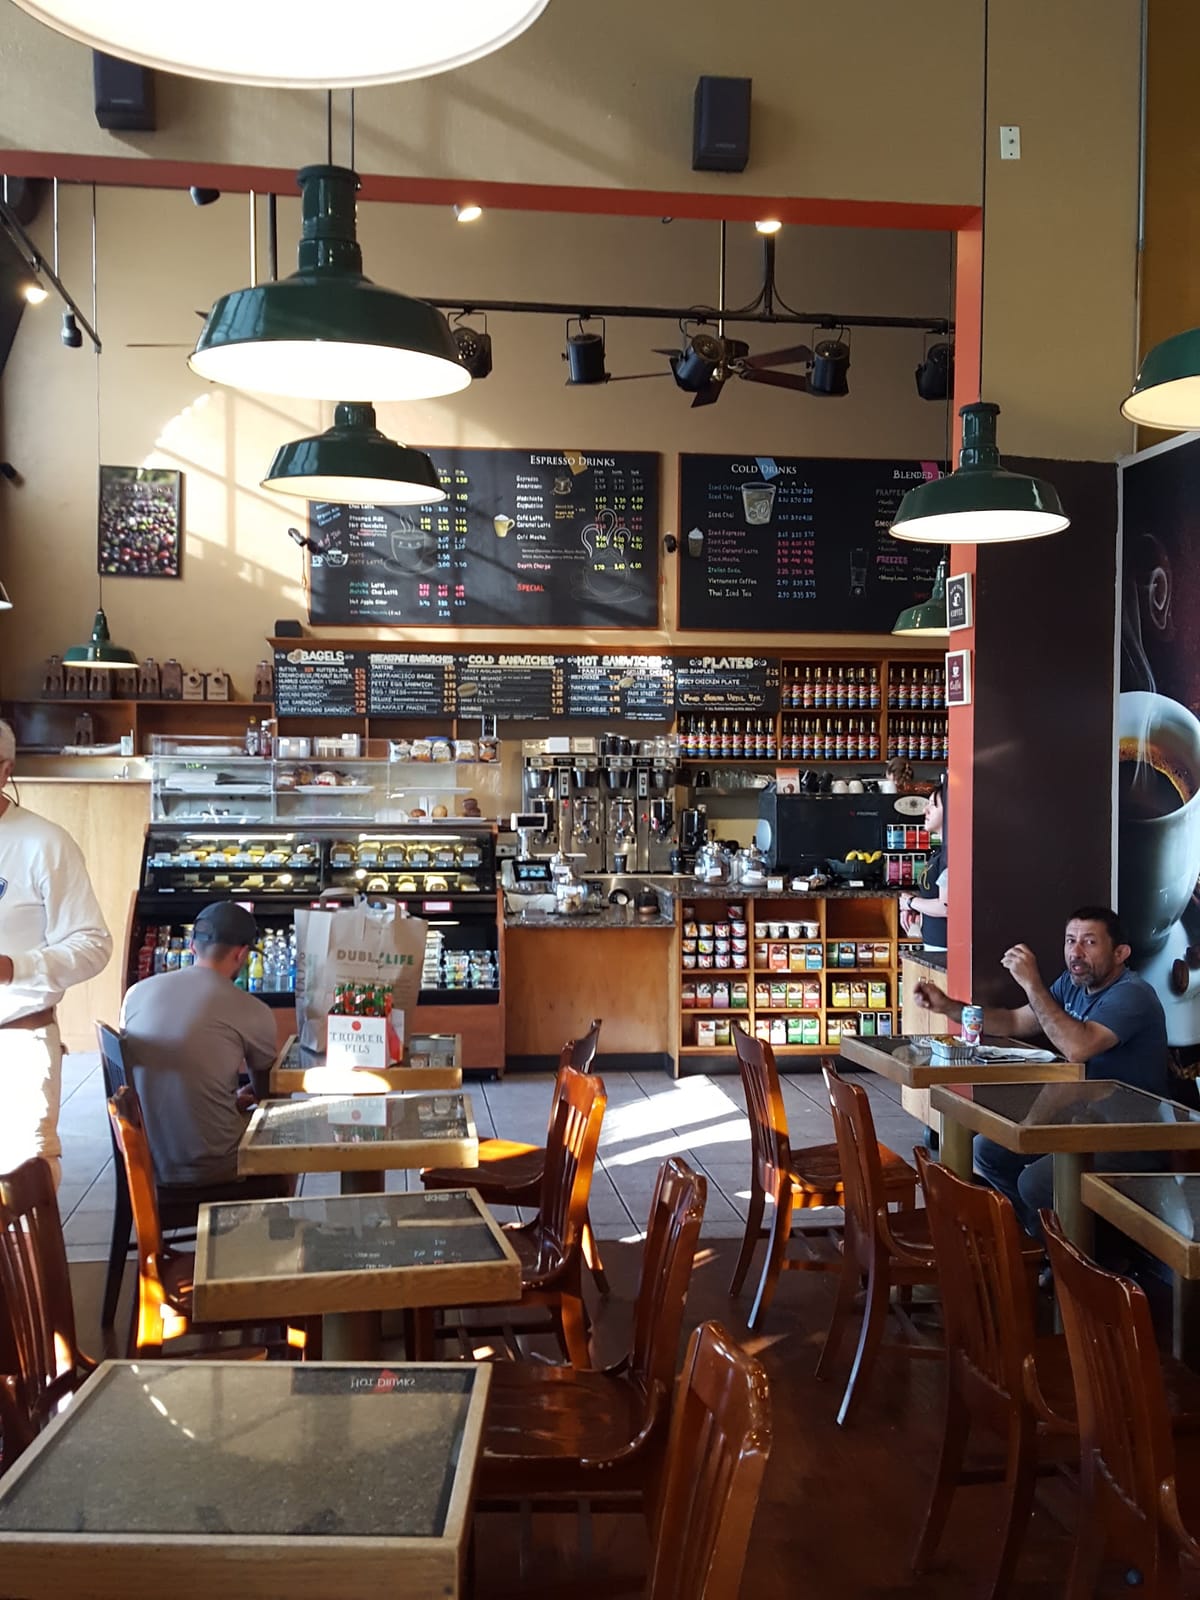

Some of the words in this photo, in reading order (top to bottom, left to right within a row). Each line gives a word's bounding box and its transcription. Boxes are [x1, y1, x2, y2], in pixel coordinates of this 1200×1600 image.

[530, 454, 576, 466] ESPRESSO
[578, 456, 616, 467] DRINKS
[731, 463, 758, 474] COLD
[761, 464, 797, 475] DRINKS
[893, 469, 934, 480] BLENDED
[708, 511, 722, 519] Iced
[722, 529, 746, 537] Espresso
[708, 588, 722, 597] Thai
[725, 588, 740, 597] Iced
[742, 588, 752, 597] Tea
[301, 650, 345, 662] BAGELS
[468, 655, 495, 664] COLD
[498, 655, 555, 666] SANDWICHES
[577, 656, 599, 666] HOT
[602, 656, 662, 668] SANDWICHES
[702, 657, 754, 669] PLATES
[385, 953, 414, 966] LIFE
[330, 1032, 384, 1045] TRUMER
[345, 1044, 371, 1054] PILS
